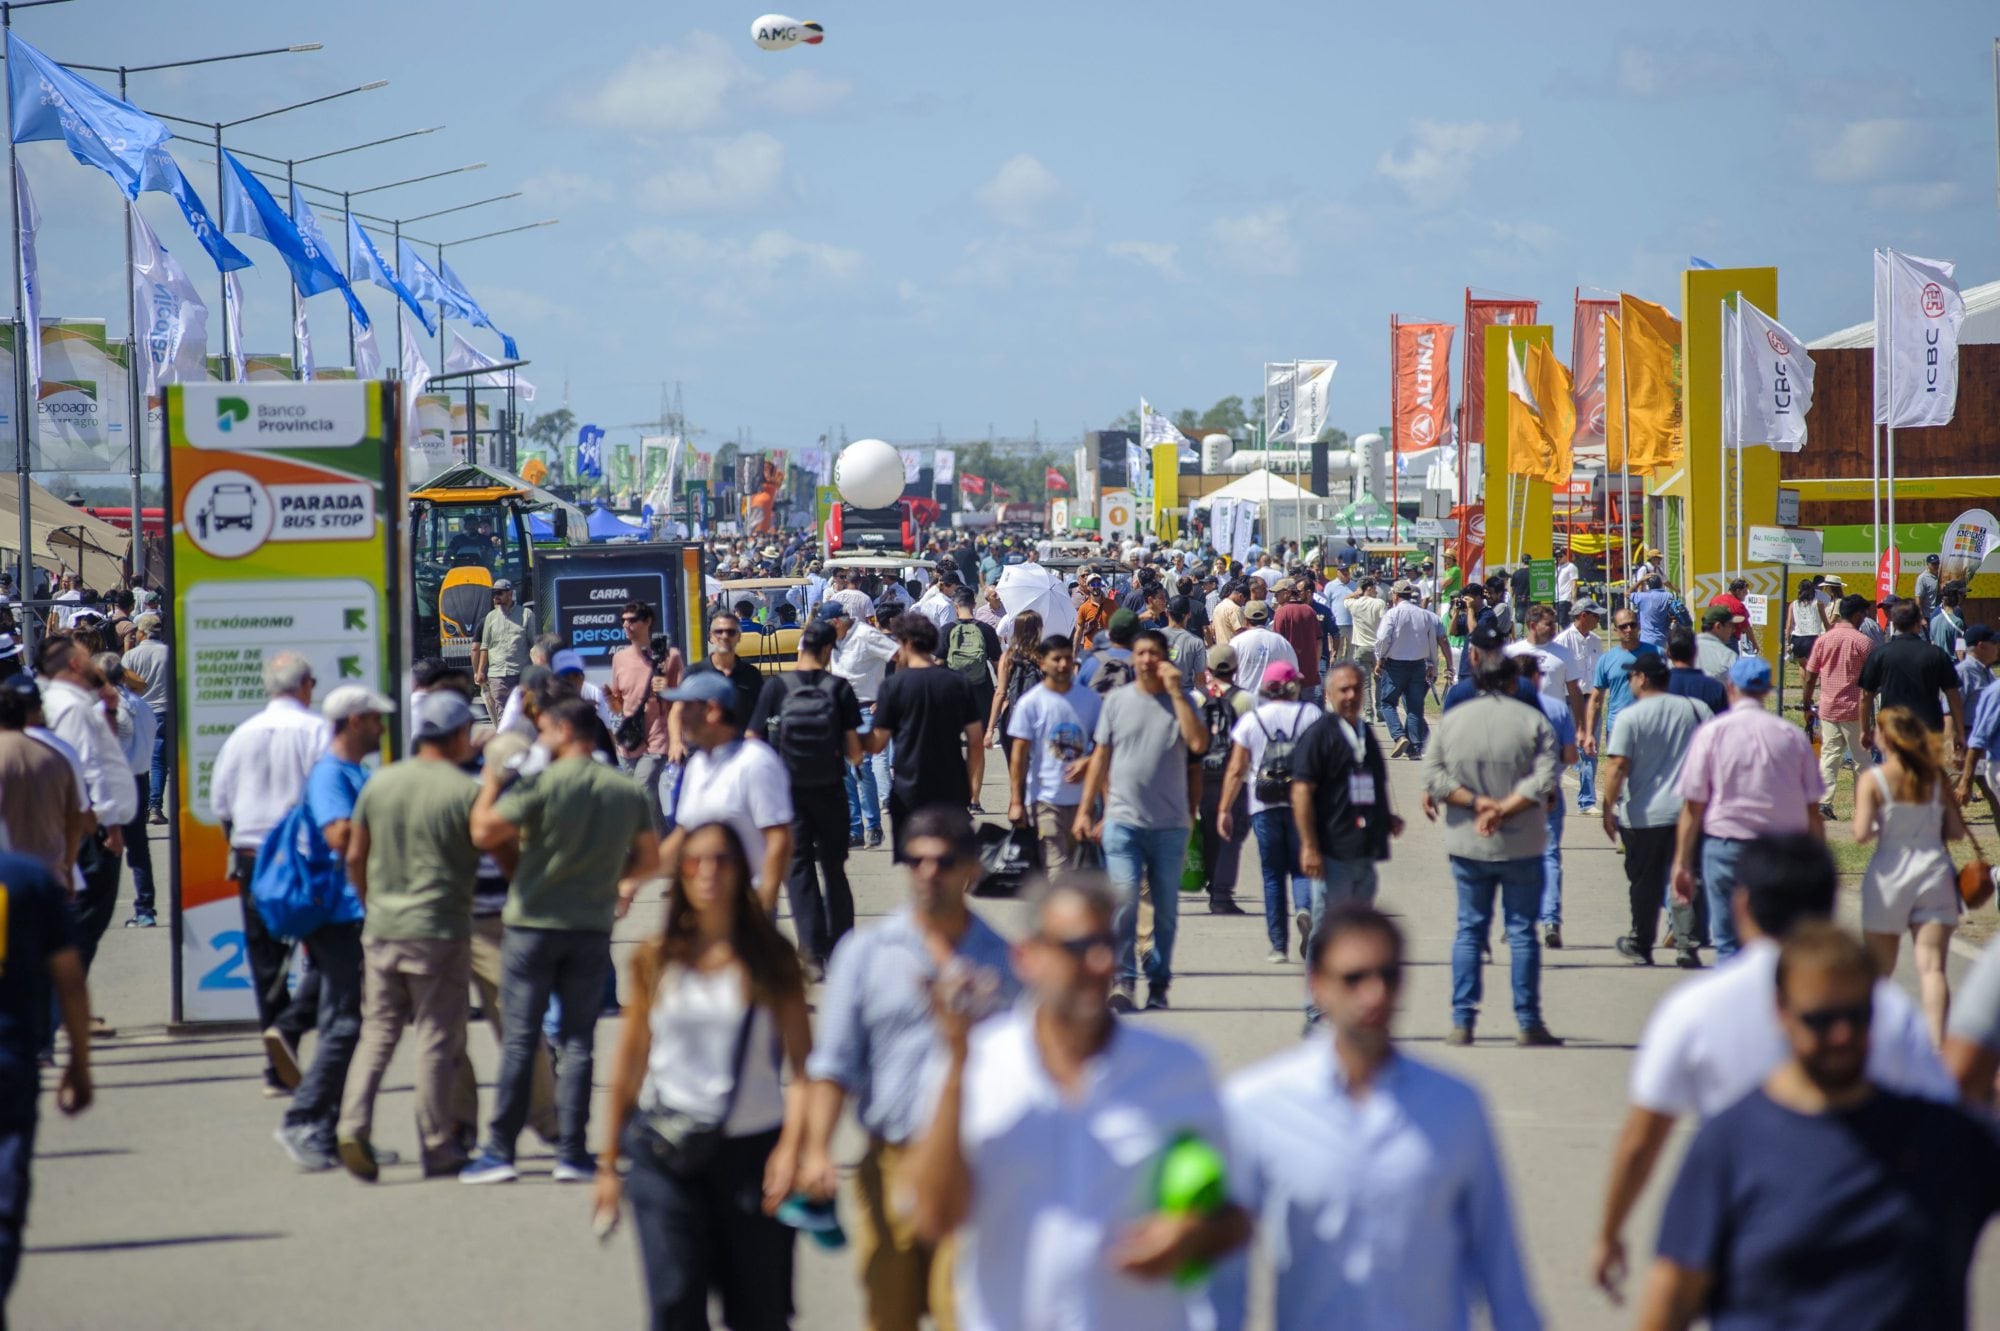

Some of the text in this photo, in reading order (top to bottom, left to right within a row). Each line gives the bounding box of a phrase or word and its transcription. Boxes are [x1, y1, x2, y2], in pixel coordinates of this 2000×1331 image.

[758, 27, 797, 41] AMG
[1926, 328, 1939, 393] ICBC
[1416, 332, 1435, 411] ALTINA
[37, 402, 98, 416] Expoagro
[258, 405, 306, 417] Banco
[74, 418, 98, 429] agro
[258, 419, 334, 432] Provincia
[280, 495, 364, 511] PARADA
[282, 514, 364, 528] BUS STOP
[1114, 510, 1123, 523] 1
[590, 588, 629, 600] CARPA
[195, 614, 294, 629] TECNÓDROMO
[572, 614, 616, 625] ESPACIO
[196, 649, 263, 660] SHOW DE
[196, 675, 264, 687] CONSTRU
[197, 689, 233, 700] JOHN
[198, 930, 253, 991] 2
